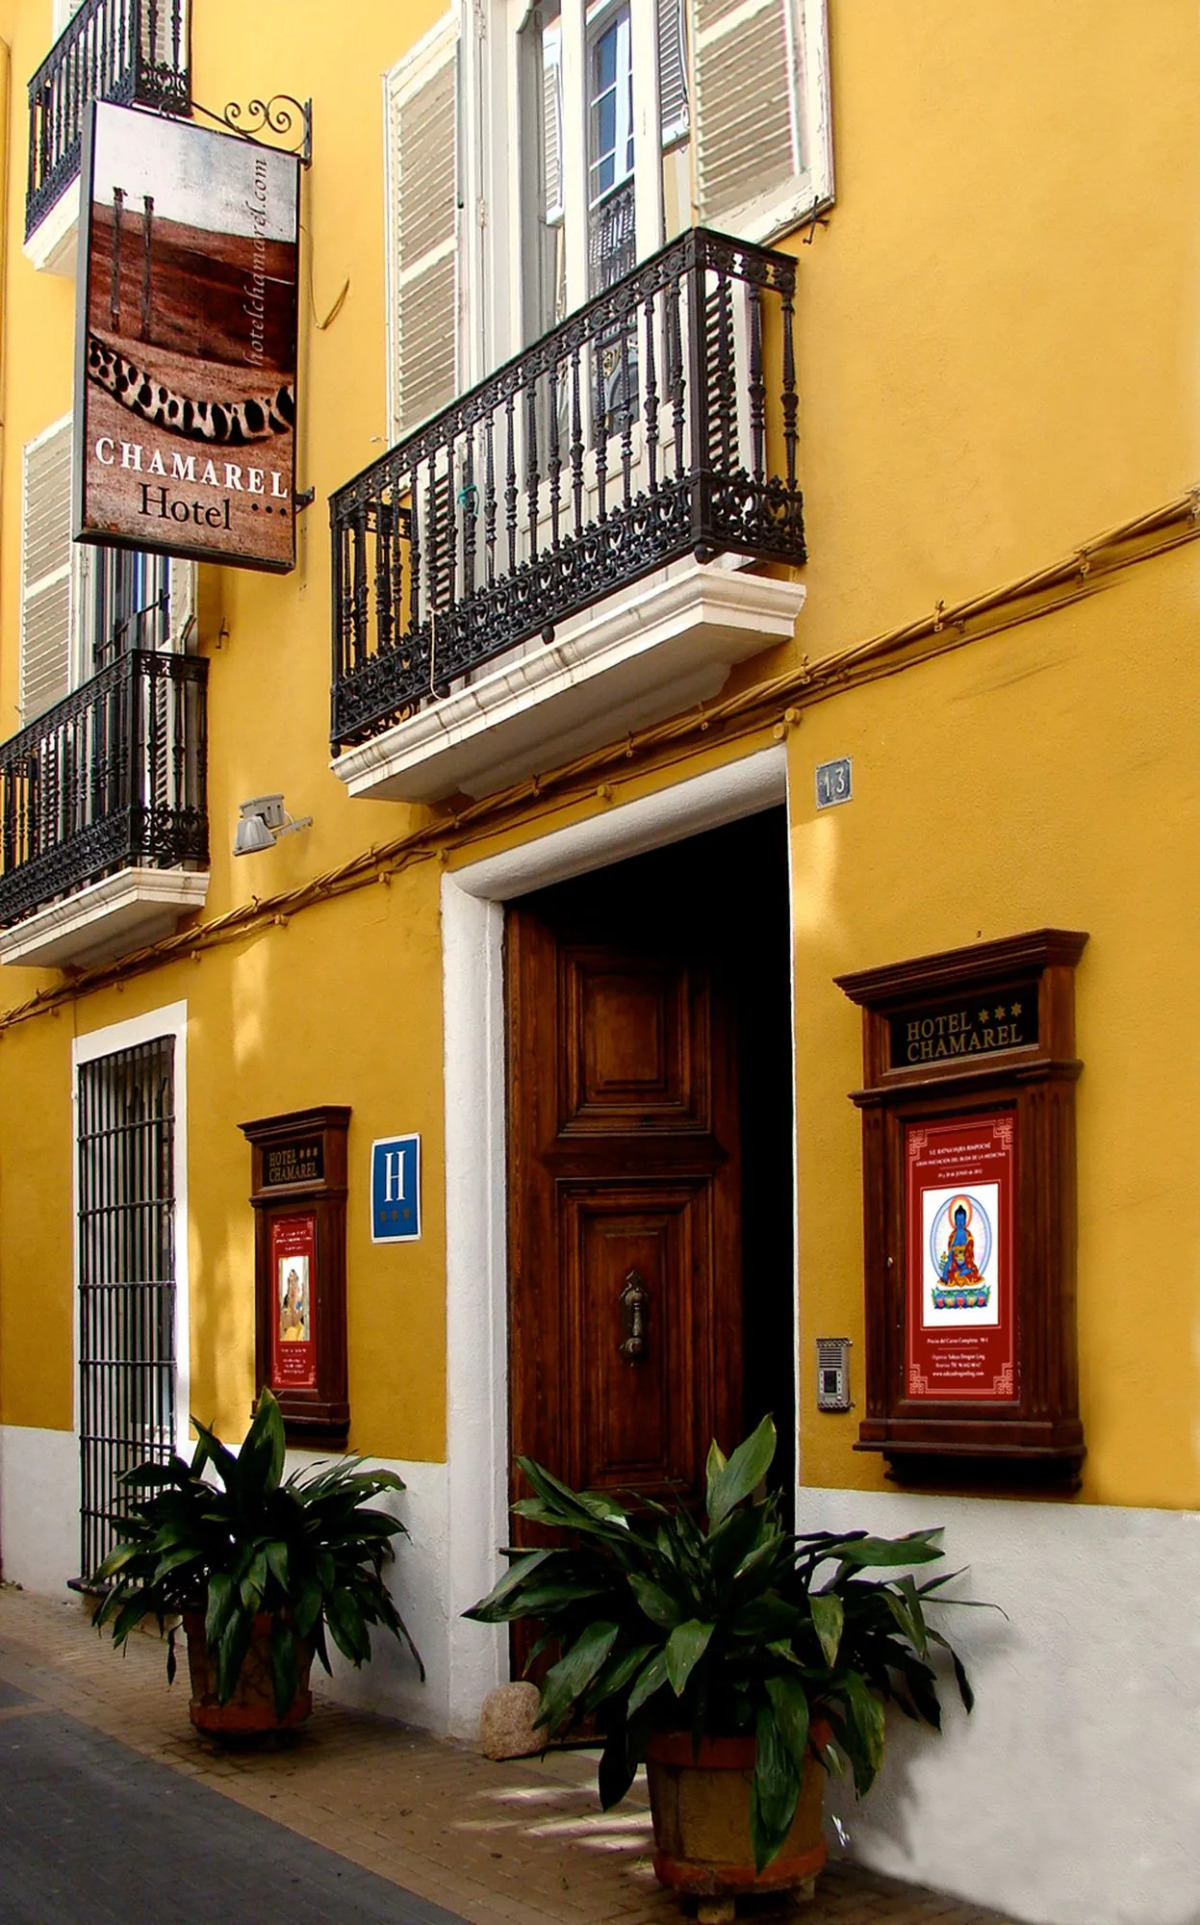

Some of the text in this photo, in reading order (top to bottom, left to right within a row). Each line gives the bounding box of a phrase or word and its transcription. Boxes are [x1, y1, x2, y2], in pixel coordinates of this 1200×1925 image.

[243, 158, 268, 367] hotelchamarel.com
[95, 437, 288, 499] CHAMAREL
[138, 482, 233, 531] Hotel
[824, 766, 845, 797] 13
[906, 1011, 972, 1042] HOTEL
[906, 1023, 1024, 1062] CHAMAREL
[269, 1149, 297, 1167] HOTEL
[269, 1161, 318, 1183] CHAMAREL
[384, 1150, 406, 1202] H
